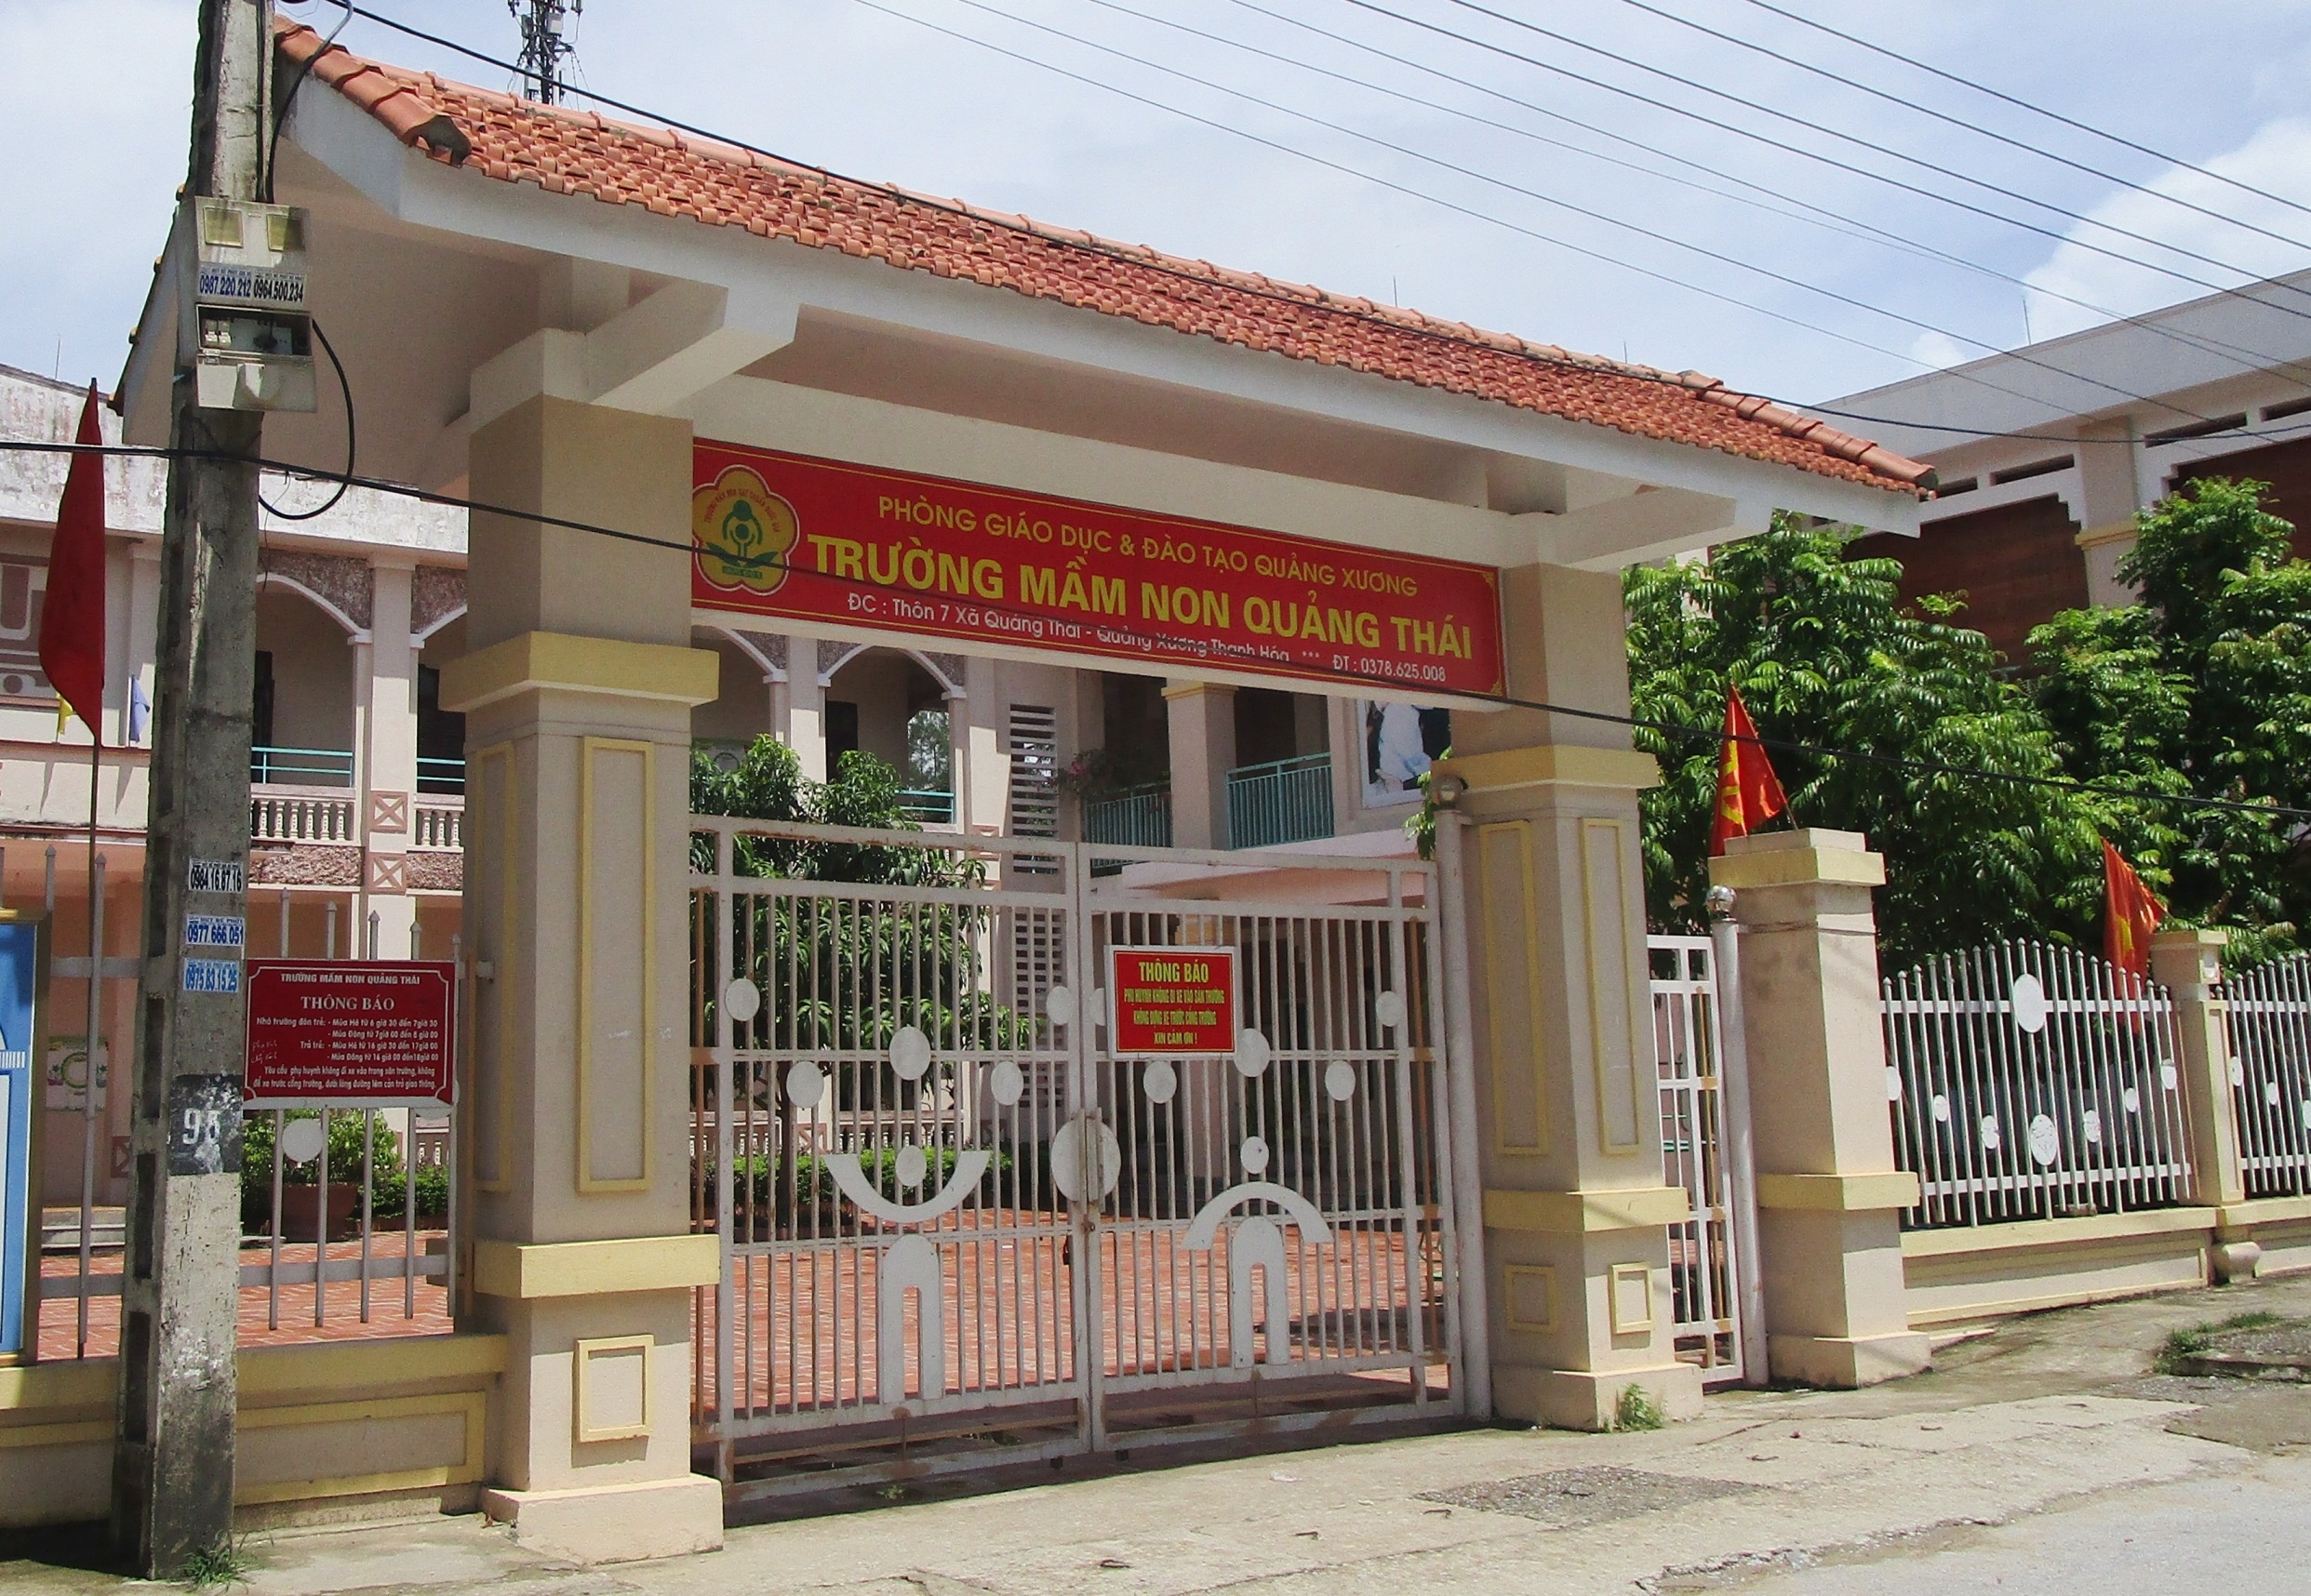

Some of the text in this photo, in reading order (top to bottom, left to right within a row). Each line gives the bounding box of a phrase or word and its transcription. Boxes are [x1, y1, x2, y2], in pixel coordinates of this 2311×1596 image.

[879, 496, 1417, 596] PHÒNG GIÁO DỤC & ĐÀO TẠO QUẢNG XƯƠNG
[808, 534, 1473, 659] TRƯỜNG MẦM NON QUẢNG THÁI
[893, 599, 934, 620] Thôn
[941, 605, 949, 621] 7
[955, 606, 979, 626] Xã
[1360, 658, 1447, 682] 0378.625.008
[281, 972, 316, 983] TRƯỜNG
[346, 975, 365, 984] NON
[367, 973, 398, 984] QUẢNG
[400, 975, 420, 985] THÁI
[1139, 958, 1209, 983] THÔNG BÁO
[301, 993, 394, 1010] THÔNG BÁO
